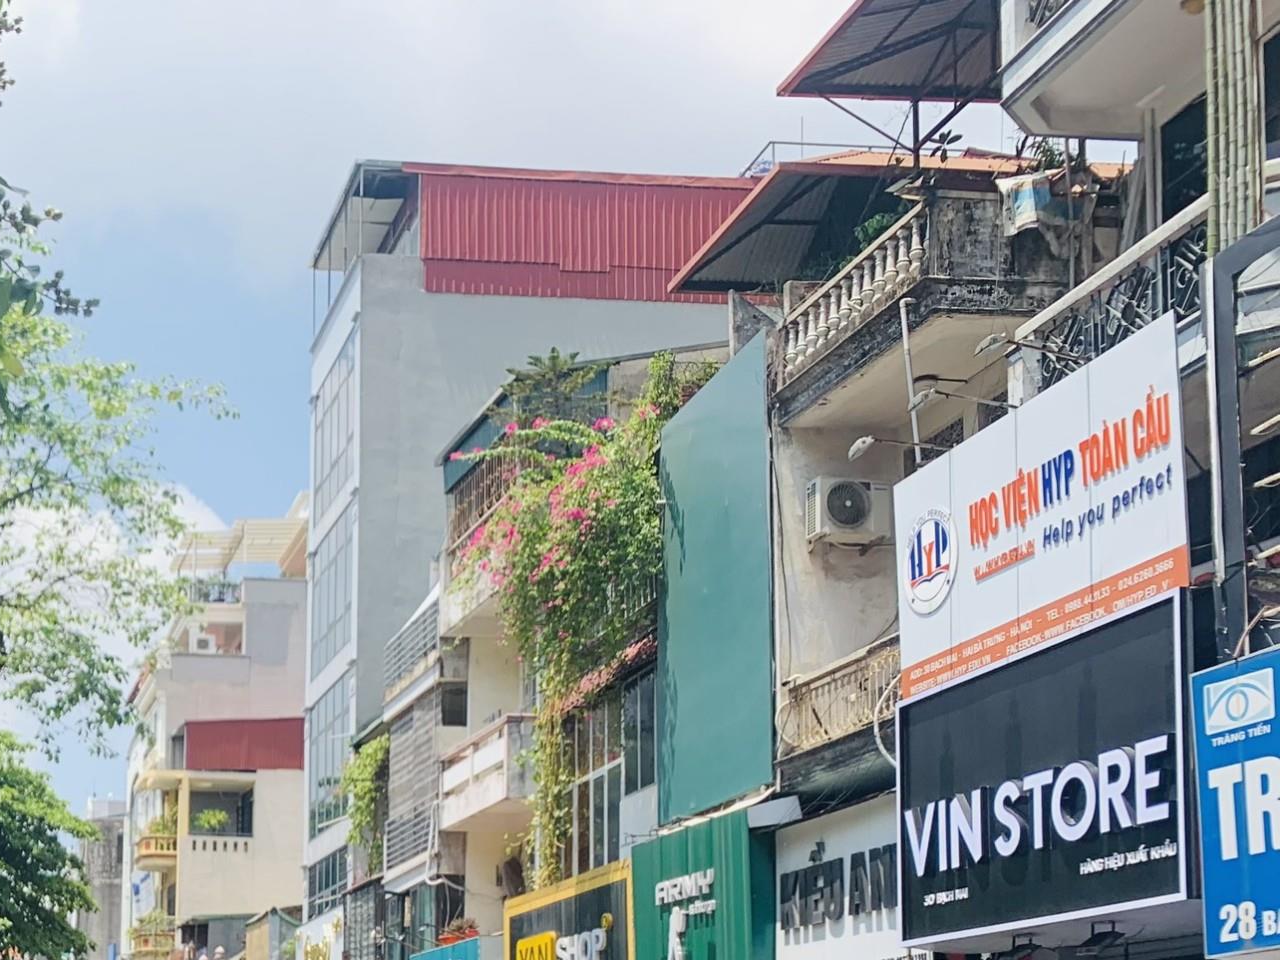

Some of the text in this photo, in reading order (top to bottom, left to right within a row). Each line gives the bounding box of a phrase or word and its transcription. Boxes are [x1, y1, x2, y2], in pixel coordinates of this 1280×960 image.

[969, 492, 999, 546] HỌC
[1002, 468, 1040, 527] VIỆN
[1041, 449, 1074, 507] HYP
[1079, 420, 1129, 487] TOÀN
[1043, 463, 1172, 548] Help you perfect
[904, 734, 1169, 877] VIN STORE
[655, 868, 715, 906] ARMY
[848, 843, 898, 916] AN
[1219, 901, 1257, 943] 28
